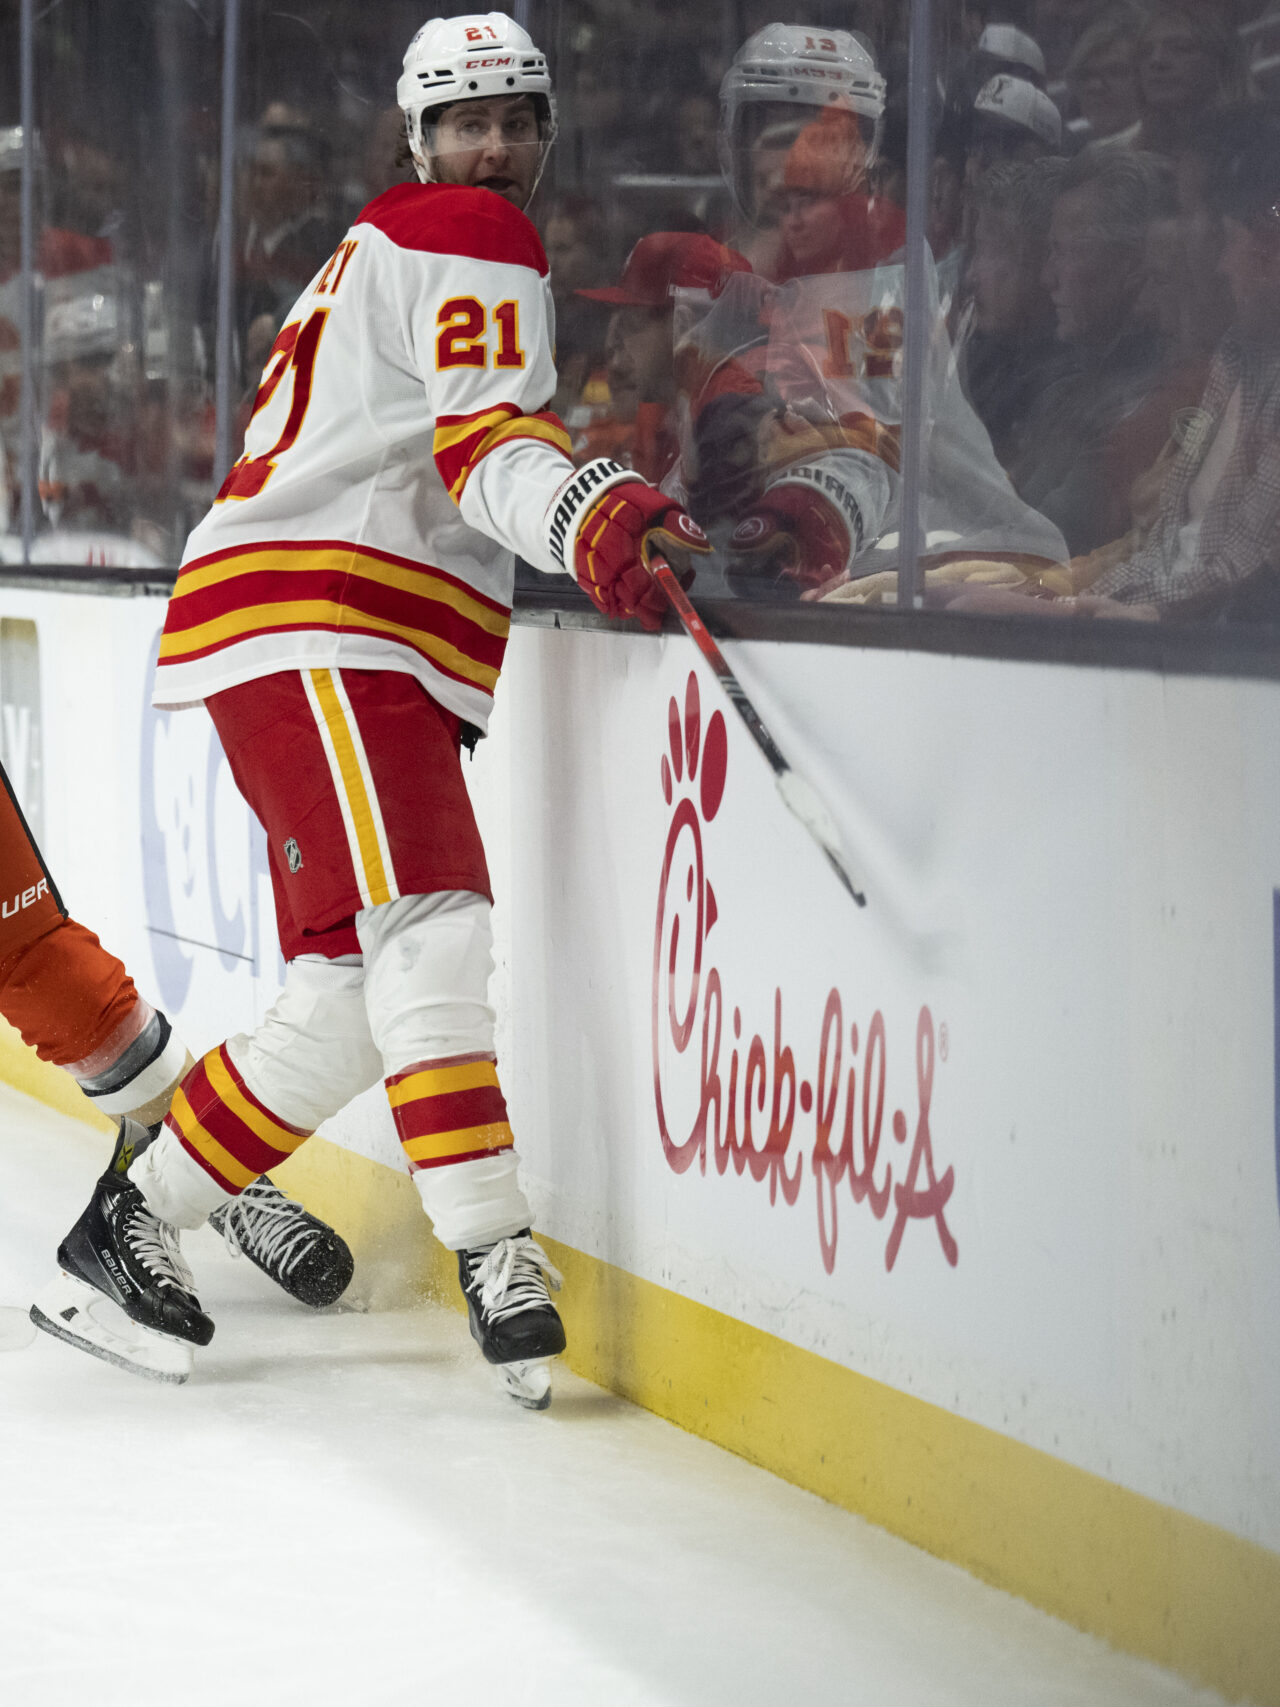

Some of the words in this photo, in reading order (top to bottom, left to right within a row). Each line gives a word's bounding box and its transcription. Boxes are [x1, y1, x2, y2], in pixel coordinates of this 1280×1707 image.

[464, 26, 497, 41] 21
[465, 57, 511, 69] CCM
[314, 240, 359, 296] EY
[436, 295, 526, 373] 21
[548, 460, 628, 571] WARRIO
[101, 1248, 133, 1295] BAUER
